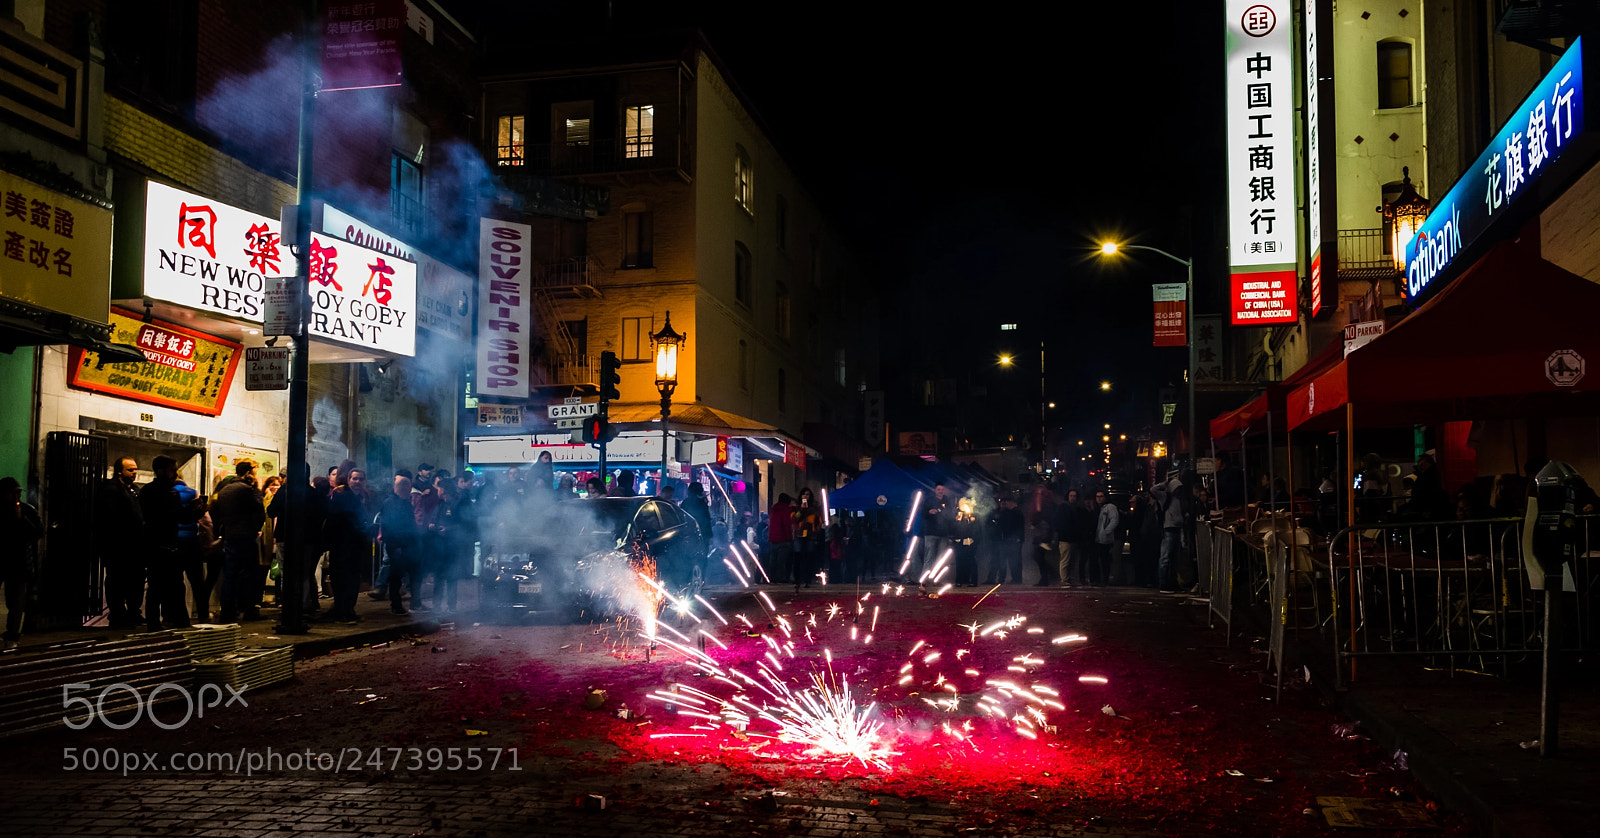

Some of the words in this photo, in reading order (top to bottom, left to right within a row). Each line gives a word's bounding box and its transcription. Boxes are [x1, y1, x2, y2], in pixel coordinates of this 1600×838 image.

[1247, 52, 1276, 235] 中国工商银行
[1484, 71, 1575, 217] 花旗銀行
[0, 190, 74, 240] 美簽證
[178, 201, 395, 307] 同樂飯店
[1409, 203, 1463, 297] citibank
[158, 248, 220, 282] NEW
[226, 265, 265, 293] WO
[313, 290, 345, 314] OY
[349, 299, 407, 329] GOEY
[488, 226, 522, 333] SOUVENIR
[1243, 281, 1270, 291] INDUSTRIAL
[1270, 280, 1282, 289] AND
[1240, 291, 1271, 300] COMMERCIAL
[1272, 290, 1286, 298] BANK
[1244, 301, 1252, 309] OF
[201, 283, 382, 345] RESRANT
[1237, 311, 1260, 320] NATIONAL
[1260, 309, 1292, 319] ASSOCIATION
[141, 329, 194, 357] 同樂飯店
[1345, 326, 1355, 340] NO
[1357, 324, 1383, 337] PARKING
[162, 355, 178, 367] LOY
[176, 359, 196, 371] GOEY
[247, 349, 259, 360] NO
[261, 350, 286, 360] PARKING
[486, 338, 520, 389] SHOP
[141, 413, 154, 423] 699
[479, 413, 488, 423] 5
[552, 404, 595, 417] GRANT
